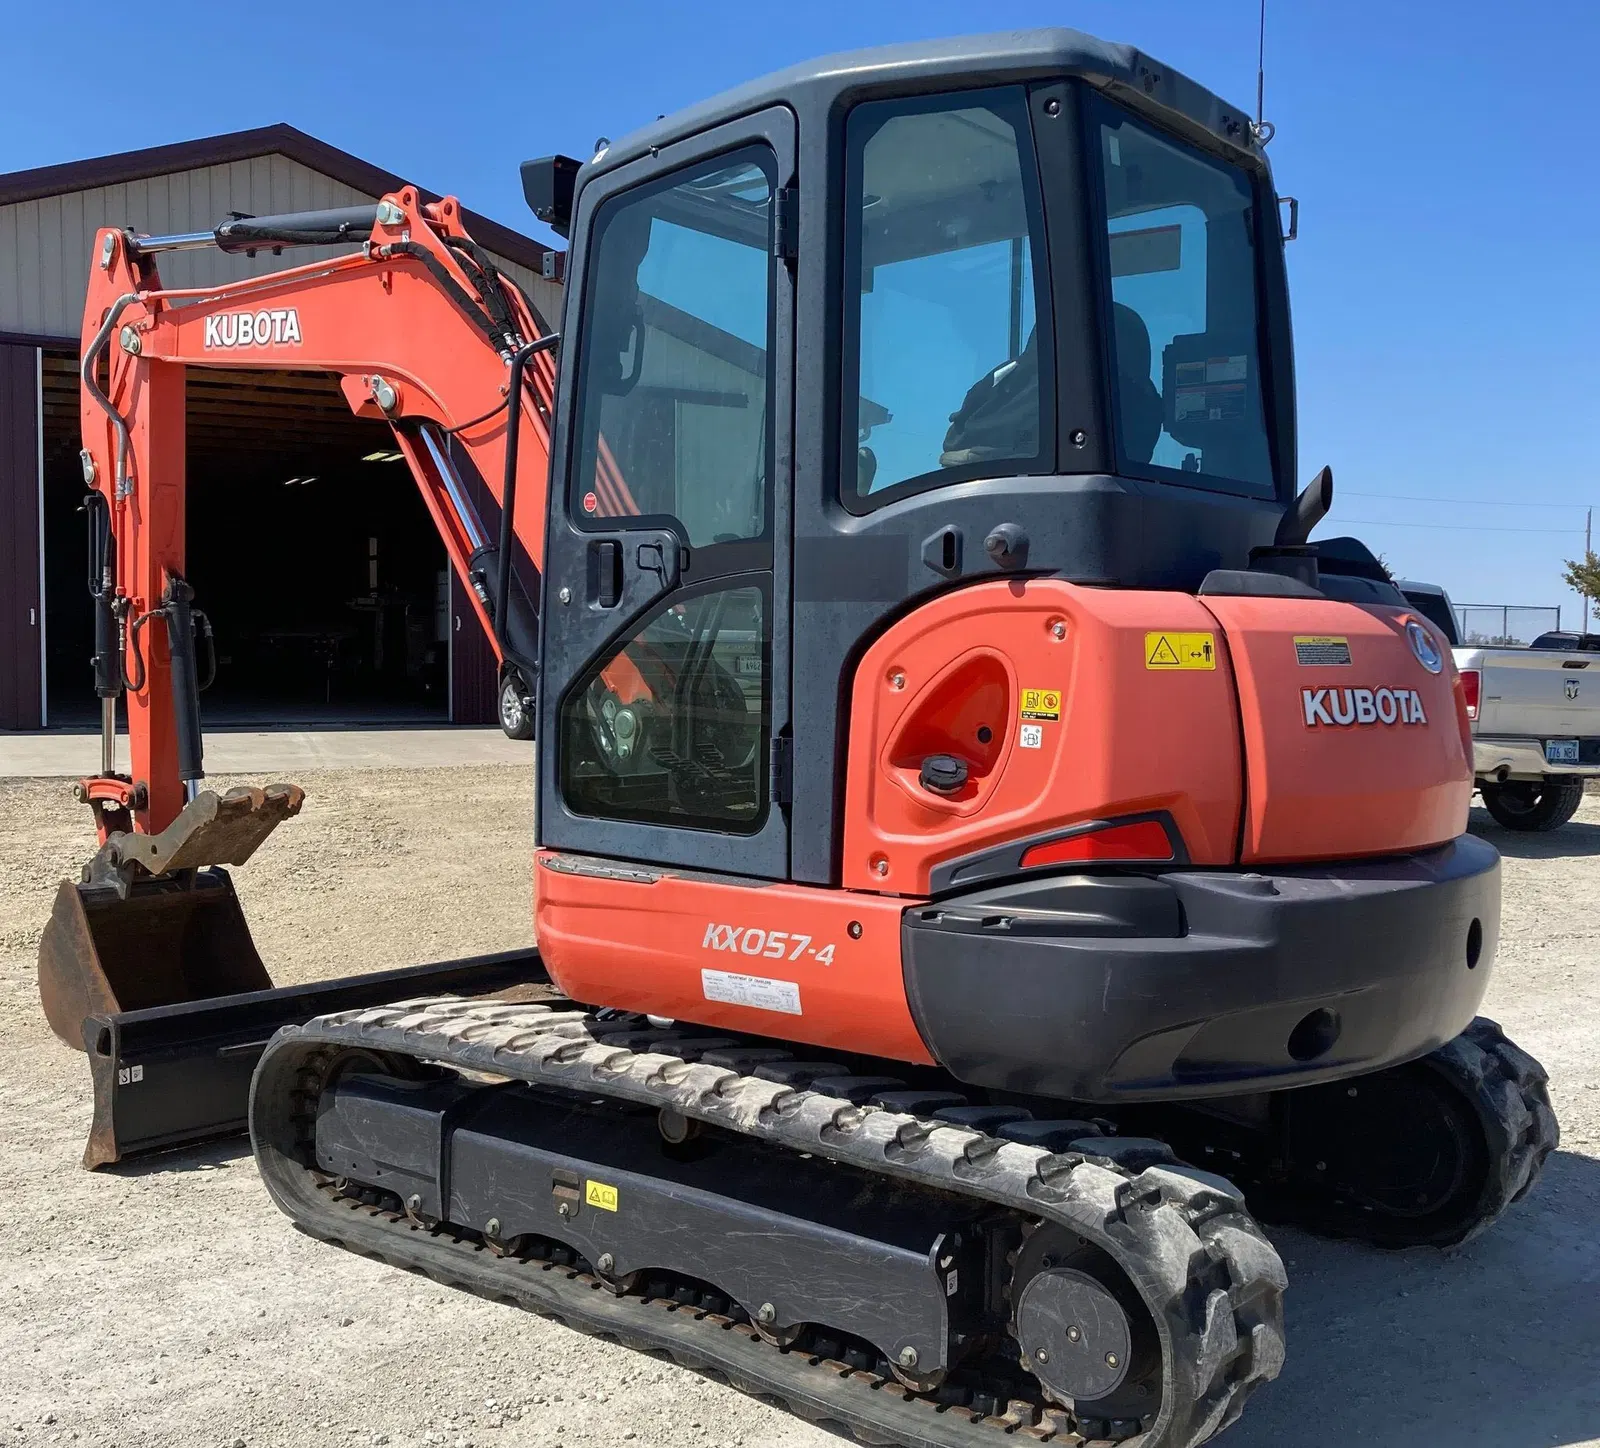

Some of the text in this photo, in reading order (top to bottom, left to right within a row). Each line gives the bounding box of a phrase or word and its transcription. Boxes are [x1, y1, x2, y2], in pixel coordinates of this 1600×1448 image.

[205, 310, 301, 347] KUBOTA
[1302, 687, 1427, 725] KUBOTA
[702, 923, 836, 966] KX057-4
